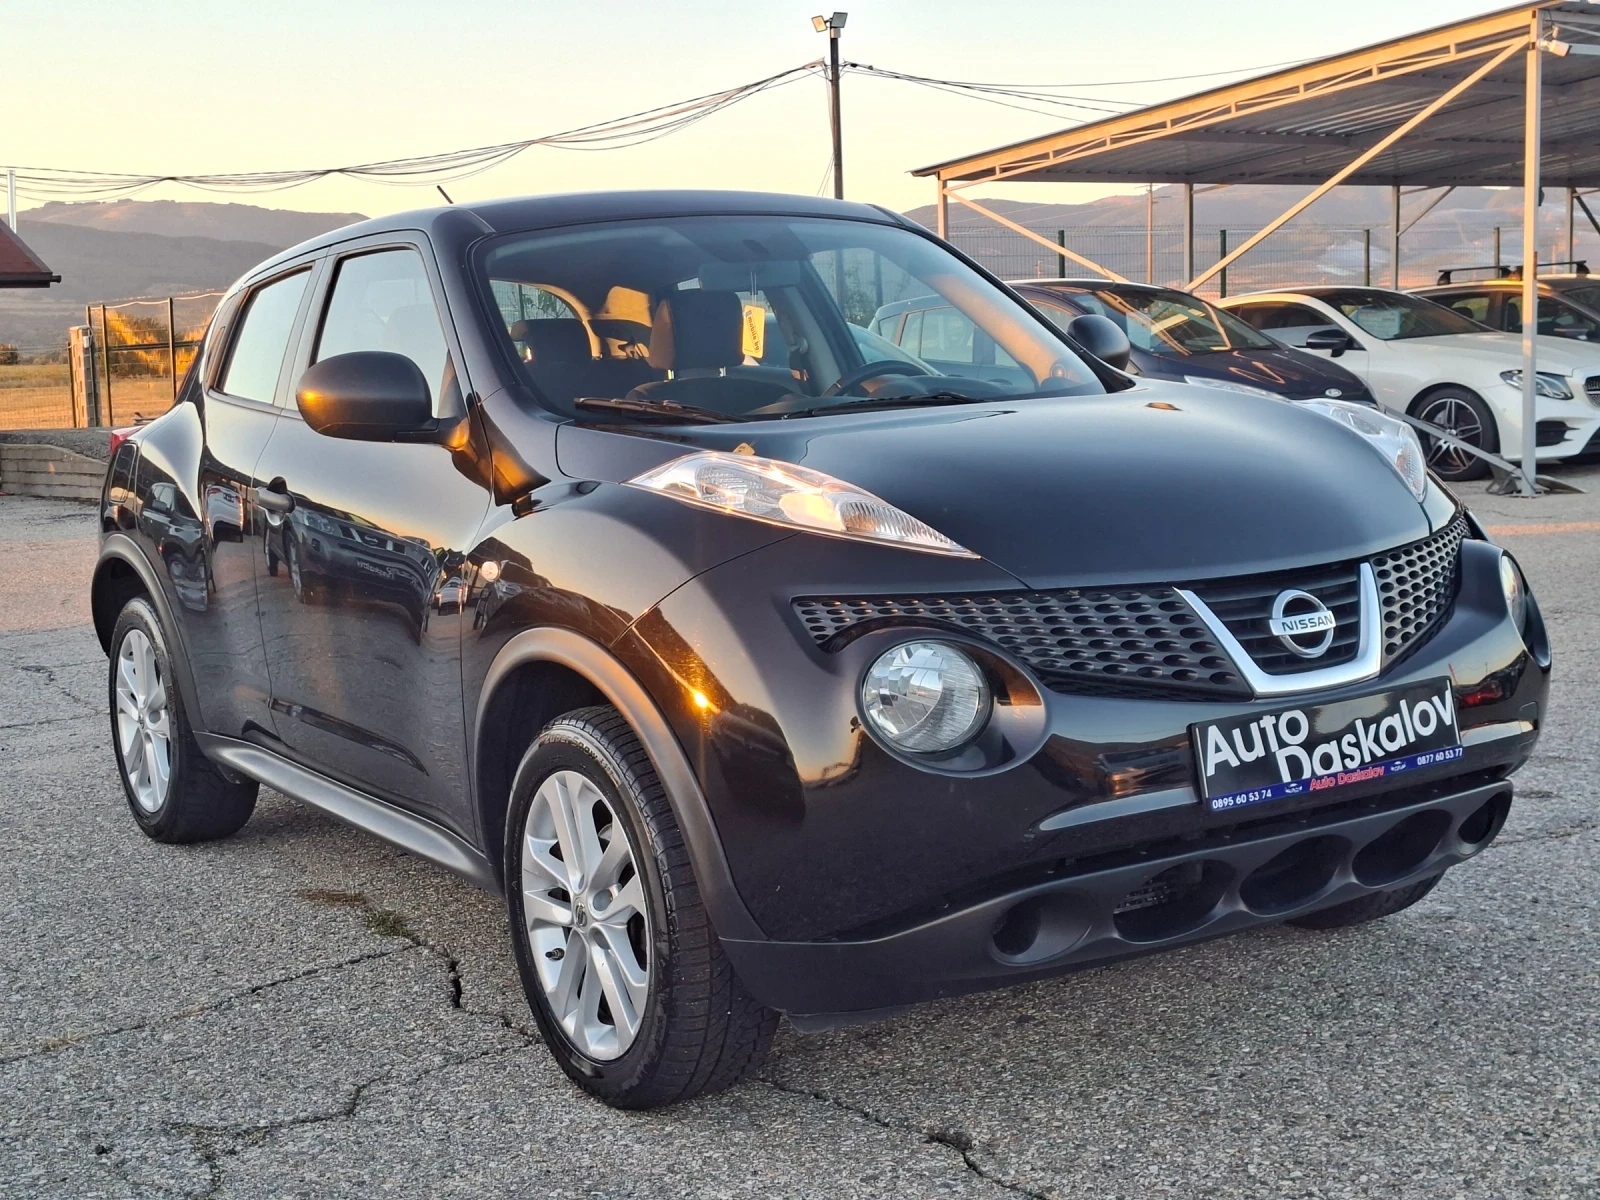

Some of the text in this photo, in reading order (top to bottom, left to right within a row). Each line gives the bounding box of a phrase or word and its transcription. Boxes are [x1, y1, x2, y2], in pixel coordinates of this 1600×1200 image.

[1281, 615, 1333, 632] NISSAN
[1206, 709, 1310, 777] Auto
[1275, 689, 1453, 783] Daskalov
[1417, 747, 1463, 766] 0877 60 53 77
[1309, 766, 1385, 791] Auto Daskalov
[1212, 788, 1272, 809] 0895 60 53 74
